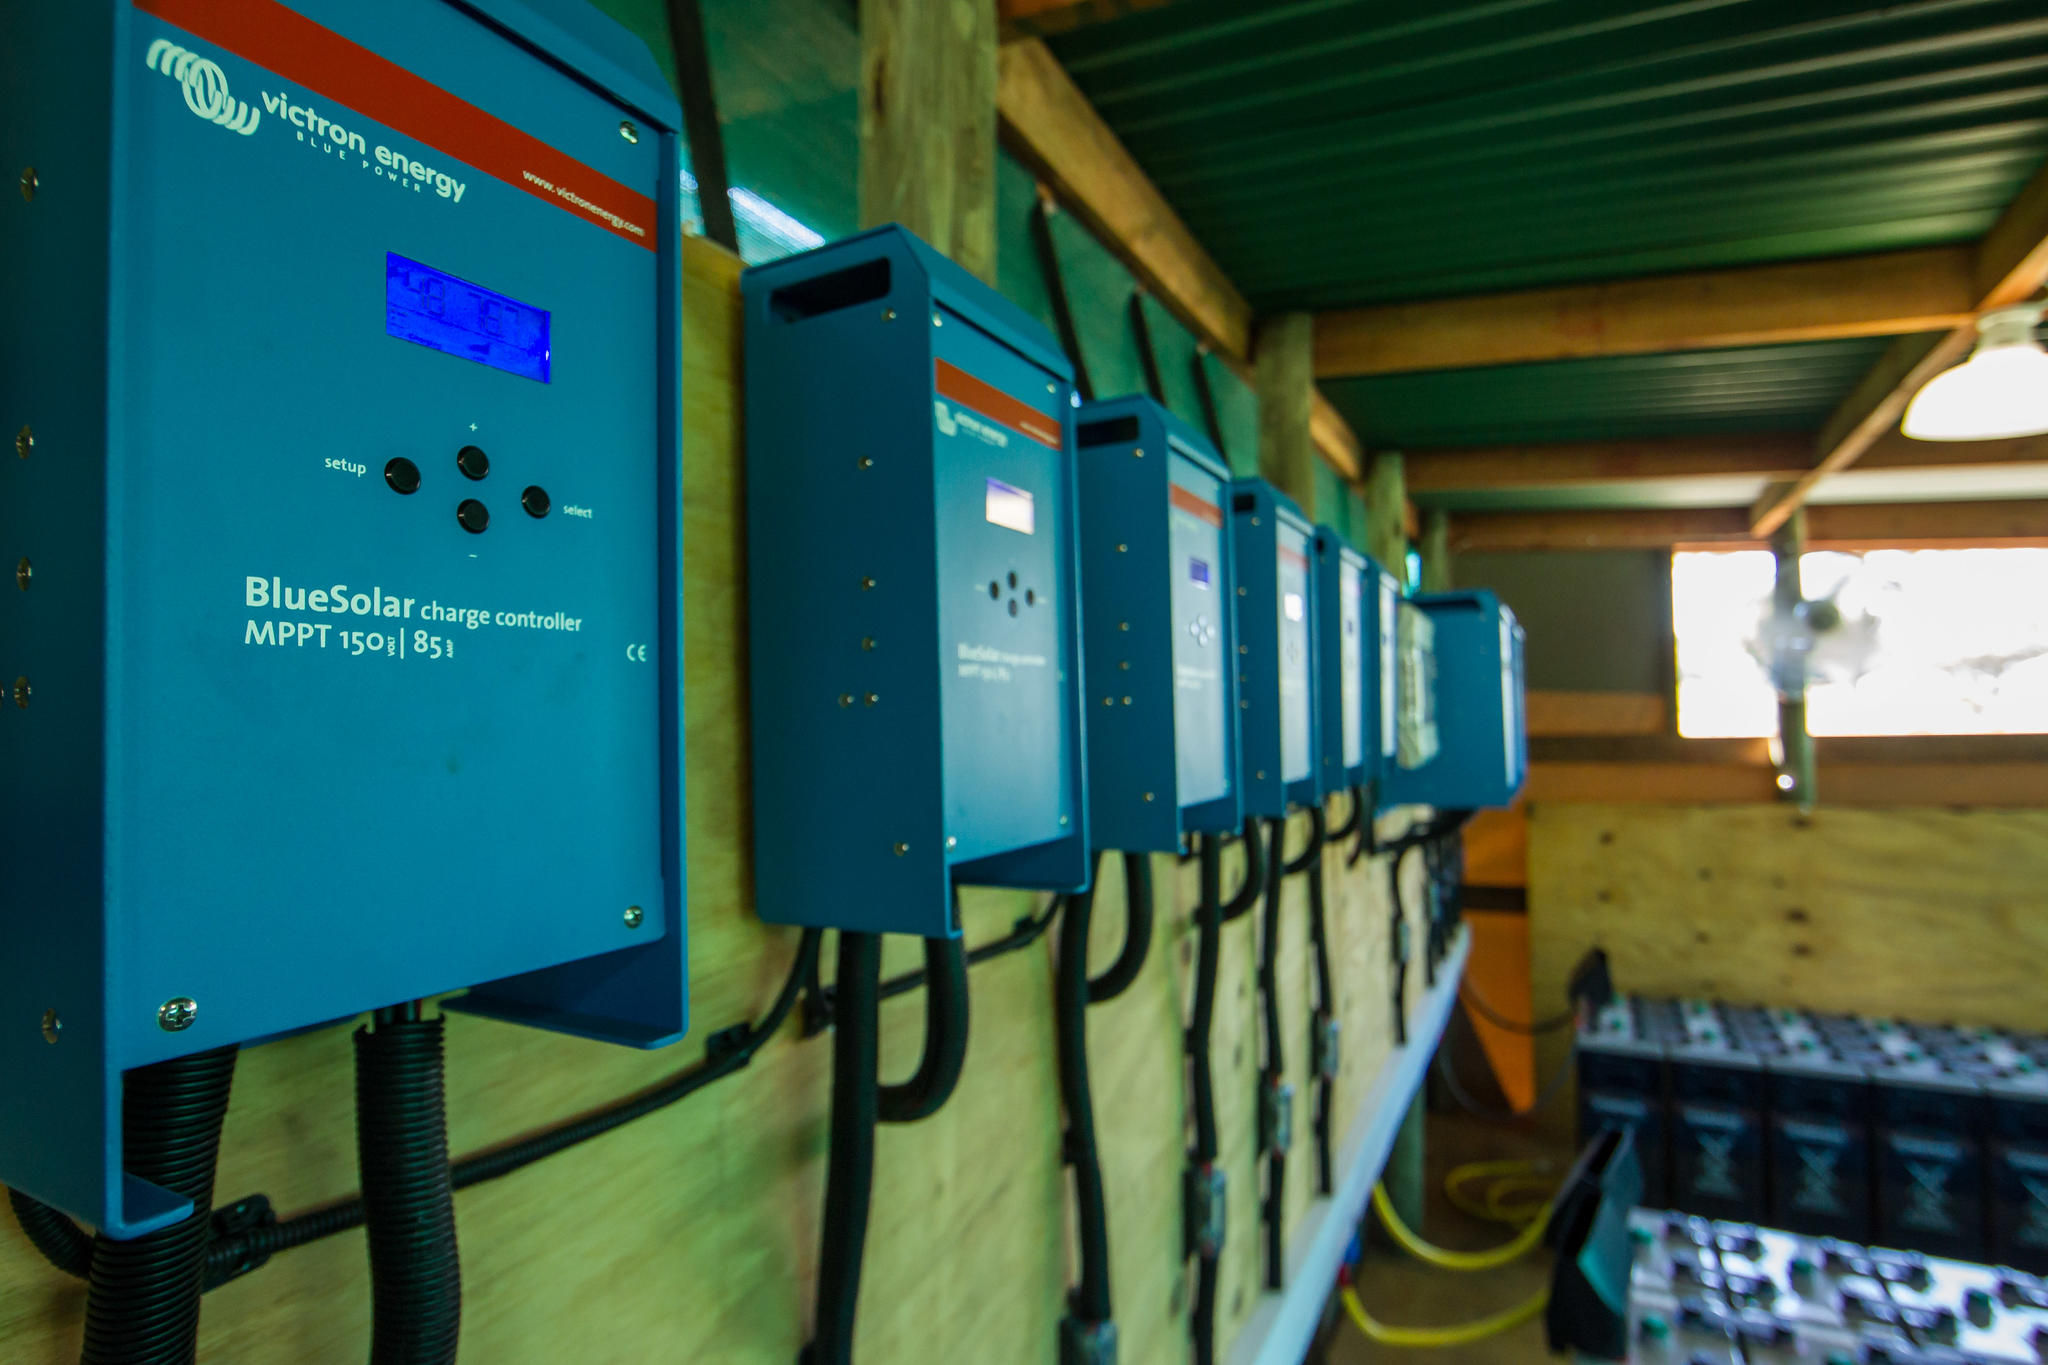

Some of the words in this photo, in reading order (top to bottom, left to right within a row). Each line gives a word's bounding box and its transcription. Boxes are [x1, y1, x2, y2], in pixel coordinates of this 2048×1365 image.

[262, 91, 366, 155] victron
[374, 145, 466, 203] energy
[296, 131, 346, 160] BLUE
[362, 160, 421, 193] POWER
[324, 457, 367, 477] setup
[563, 504, 592, 519] select
[245, 576, 415, 618] BlueSolar
[420, 600, 490, 630] charge
[495, 601, 582, 632] controller
[245, 619, 332, 648] MPPT
[339, 631, 384, 656] 150
[387, 636, 396, 657] VOLT
[413, 630, 442, 659] 85
